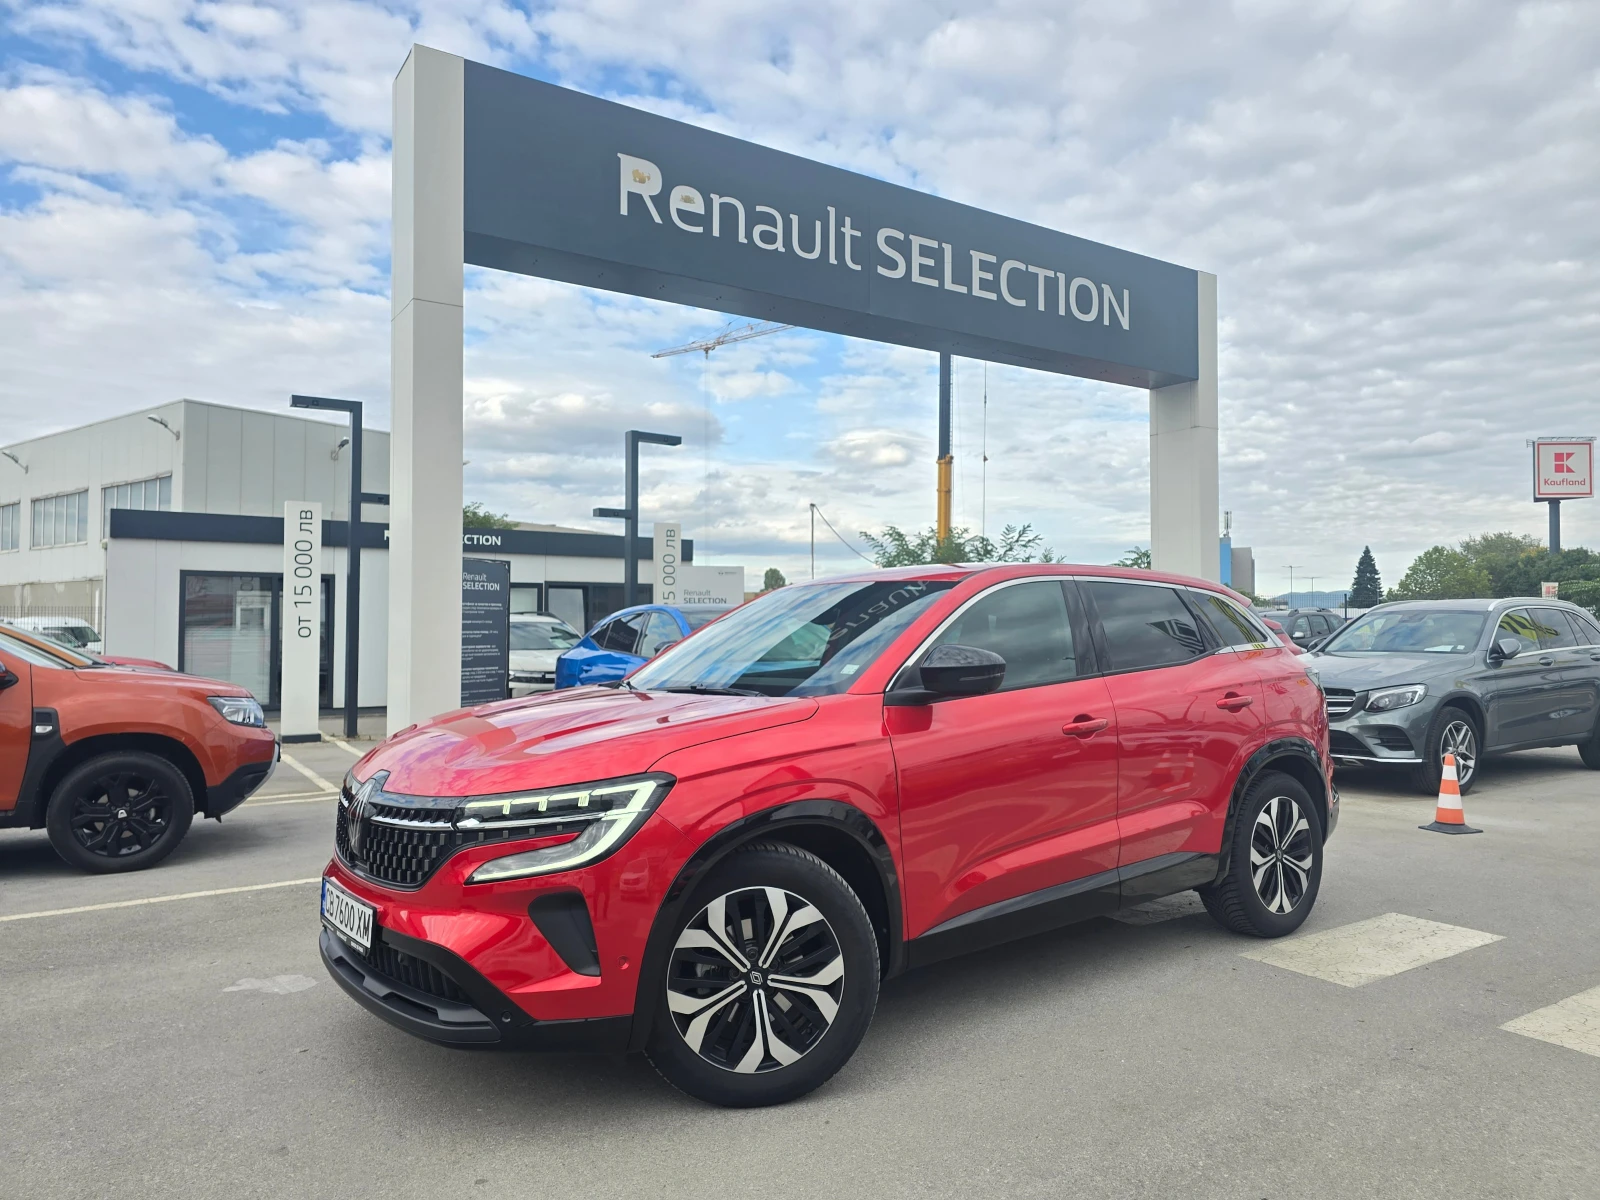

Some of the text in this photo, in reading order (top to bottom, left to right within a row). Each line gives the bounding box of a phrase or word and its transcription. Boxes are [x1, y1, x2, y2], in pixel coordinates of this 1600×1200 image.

[617, 153, 1130, 330] Renault SELECTION
[1544, 478, 1586, 486] Kaufland
[462, 534, 501, 546] CTION
[294, 510, 313, 638] от 15 000 лв
[463, 572, 487, 581] Renault
[662, 553, 676, 586] 000
[463, 582, 500, 591] SELECTION
[326, 887, 334, 917] CB
[335, 895, 355, 932] 7600
[356, 907, 371, 942] XM
